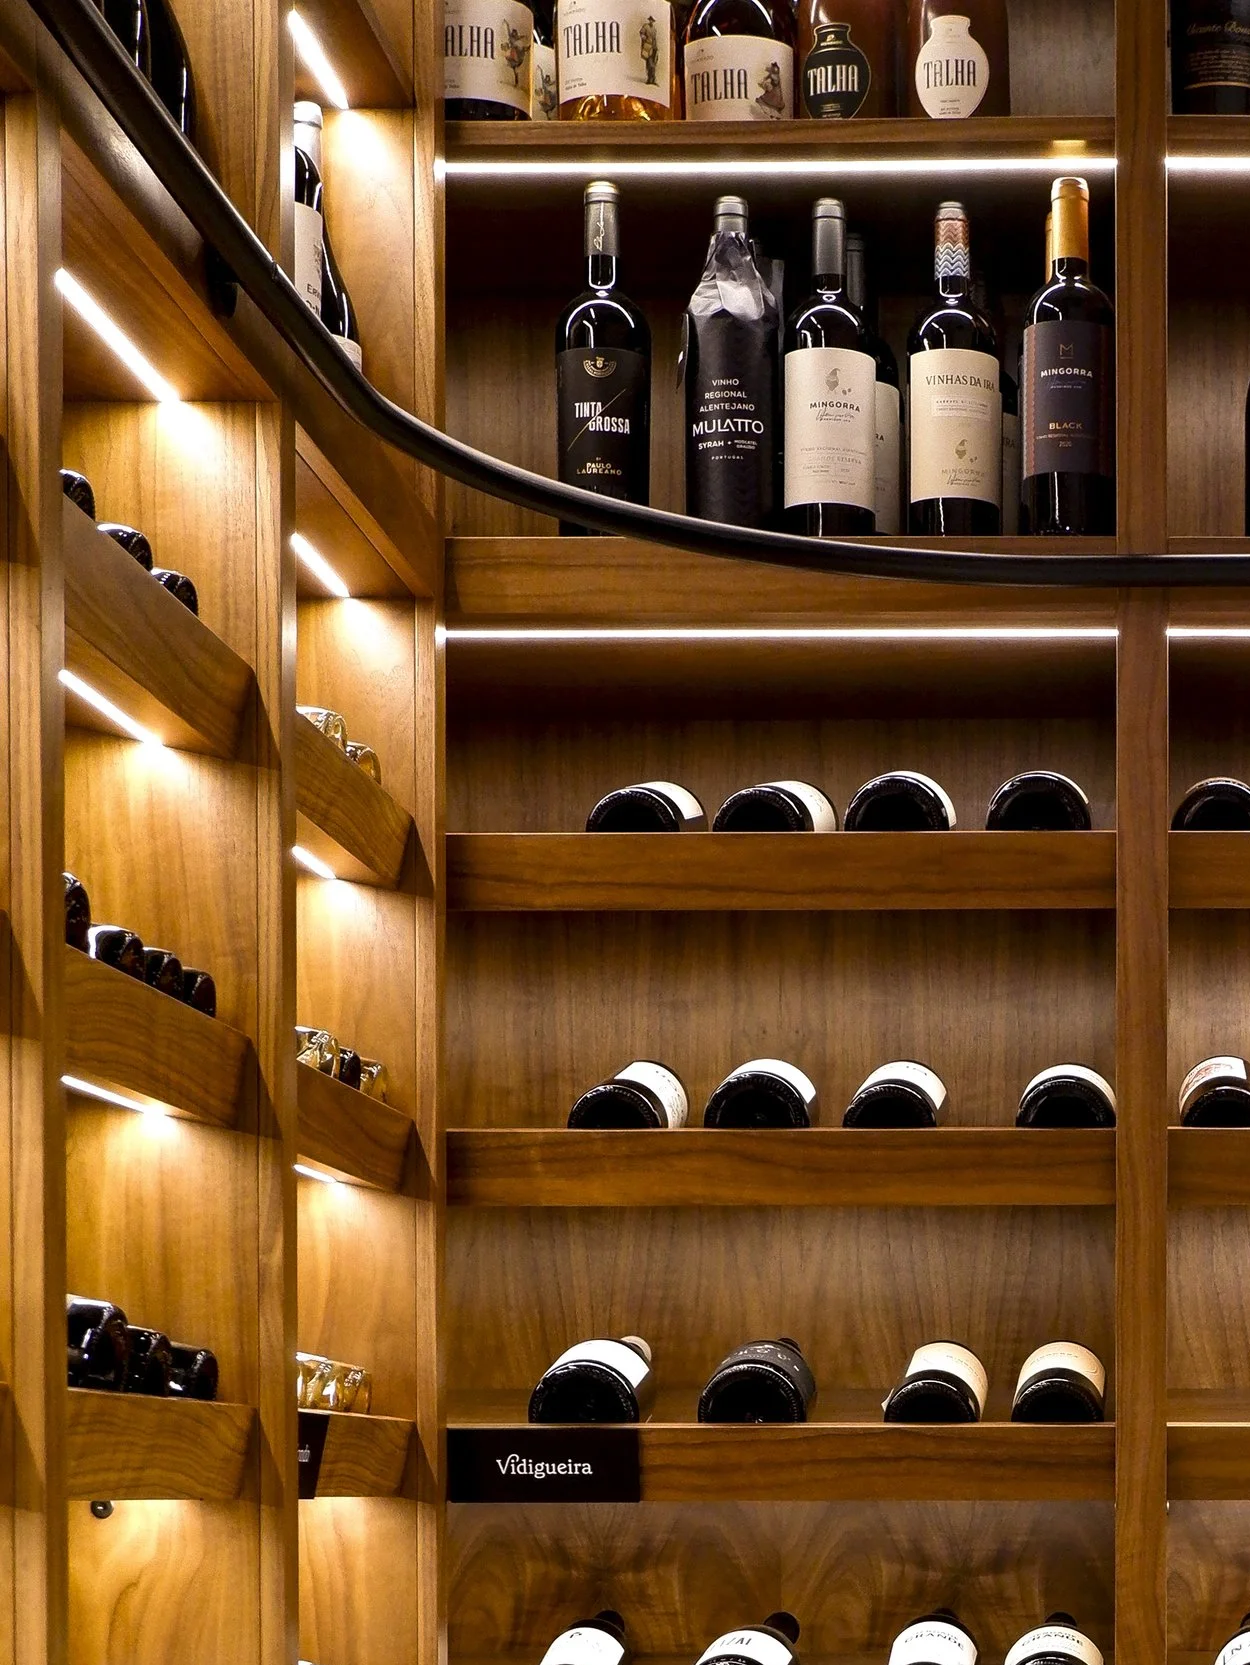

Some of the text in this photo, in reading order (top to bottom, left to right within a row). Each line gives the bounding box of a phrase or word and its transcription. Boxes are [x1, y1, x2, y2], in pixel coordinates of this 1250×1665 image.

[444, 25, 496, 60] ALHA
[563, 21, 622, 59] TALHA
[807, 64, 860, 97] TALHA
[923, 59, 978, 89] TALHA
[690, 68, 751, 105] TALHA
[1041, 367, 1093, 379] MINGORRA
[712, 379, 740, 387] VINHO
[925, 374, 968, 387] VINHAS
[969, 377, 982, 388] DA
[704, 391, 748, 400] REGIONAL
[574, 402, 602, 419] TINTA
[699, 402, 756, 413] ALENTEJANO
[809, 401, 862, 414] MINGORRA
[588, 416, 630, 435] GROSSA
[692, 418, 765, 437] MULATTO
[1049, 422, 1083, 431] BLACK
[698, 440, 725, 451] SYRAH
[576, 468, 623, 476] LAUREANO
[586, 462, 612, 471] PAULO
[496, 1453, 593, 1479] Vidigueira
